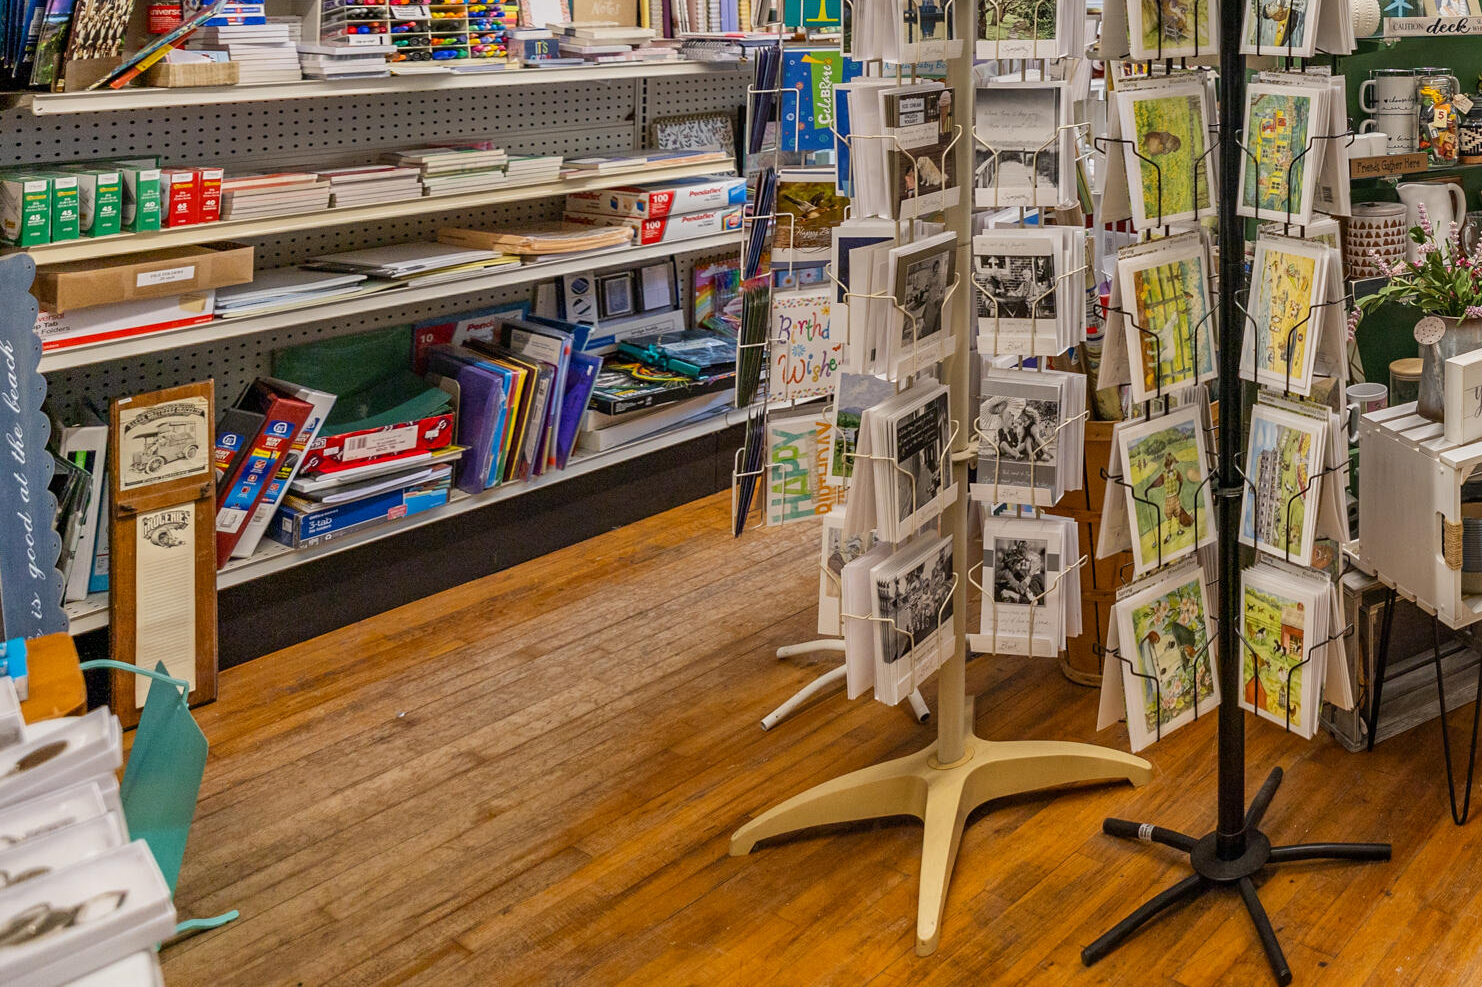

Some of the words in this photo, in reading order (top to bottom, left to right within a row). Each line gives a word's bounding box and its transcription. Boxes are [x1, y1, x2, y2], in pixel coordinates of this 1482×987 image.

[1426, 17, 1471, 34] deck
[1438, 111, 1444, 120] 5
[1357, 162, 1380, 174] Friends
[1381, 161, 1402, 175] Gather
[1404, 158, 1420, 169] Here
[653, 194, 668, 204] 100
[688, 186, 723, 198] Pendaflex
[645, 220, 661, 230] 100
[1, 339, 23, 413] beach
[9, 422, 26, 465] the
[19, 479, 31, 503] at
[309, 519, 332, 529] 3-tab
[18, 521, 46, 580] good
